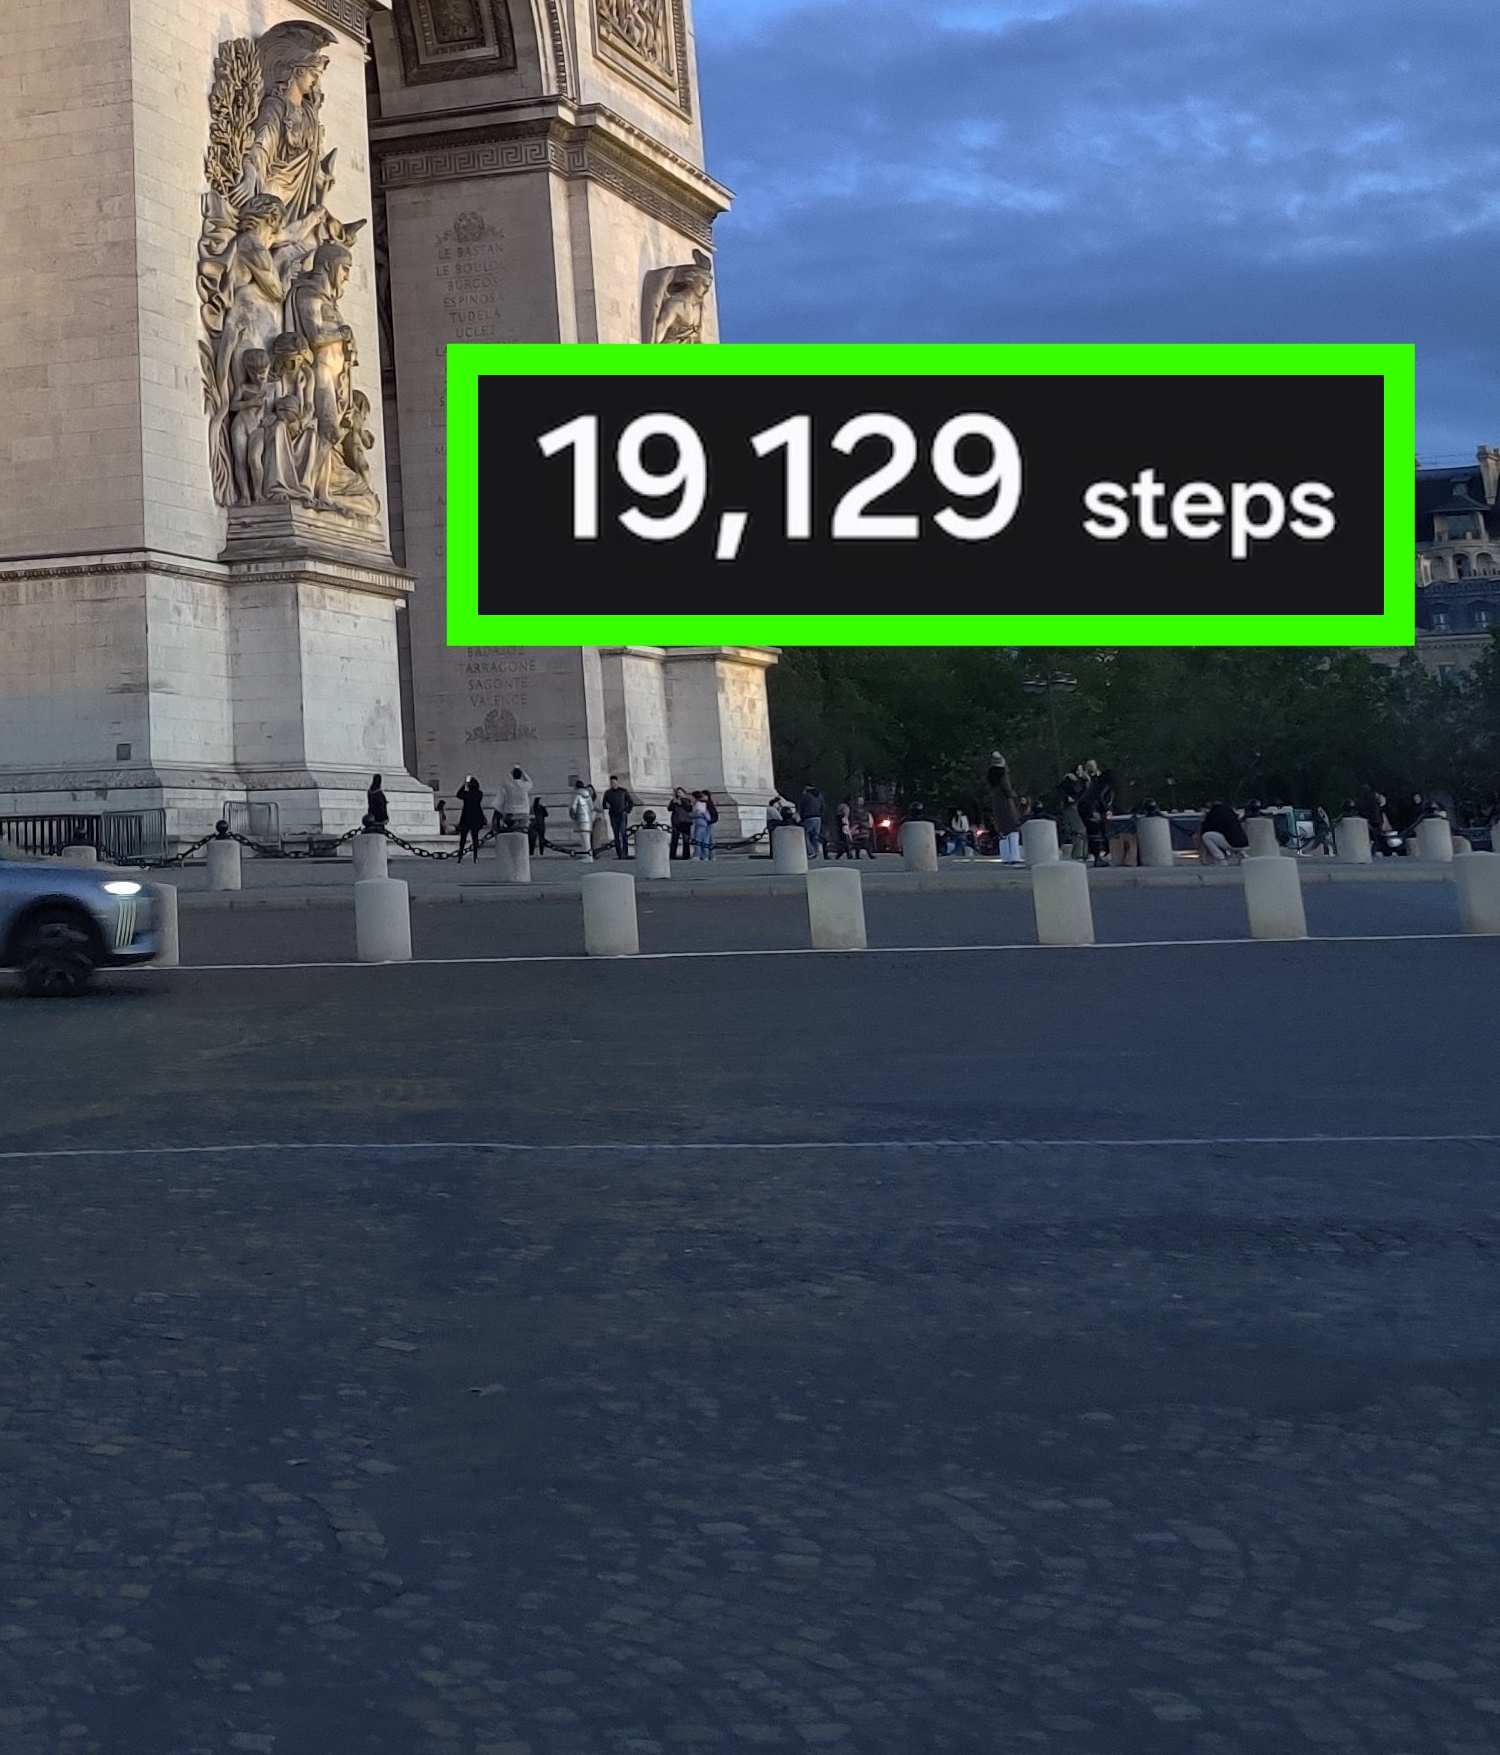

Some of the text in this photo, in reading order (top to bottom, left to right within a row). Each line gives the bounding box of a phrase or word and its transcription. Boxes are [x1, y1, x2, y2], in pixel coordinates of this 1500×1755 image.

[438, 244, 503, 259] LE BASTAN
[435, 265, 450, 277] LE
[447, 277, 500, 292] BURGOS
[448, 308, 501, 323] TUDELA
[458, 659, 536, 674] TARRAGONE
[468, 676, 529, 691] SAGONTE
[468, 693, 527, 707] VALENCE
